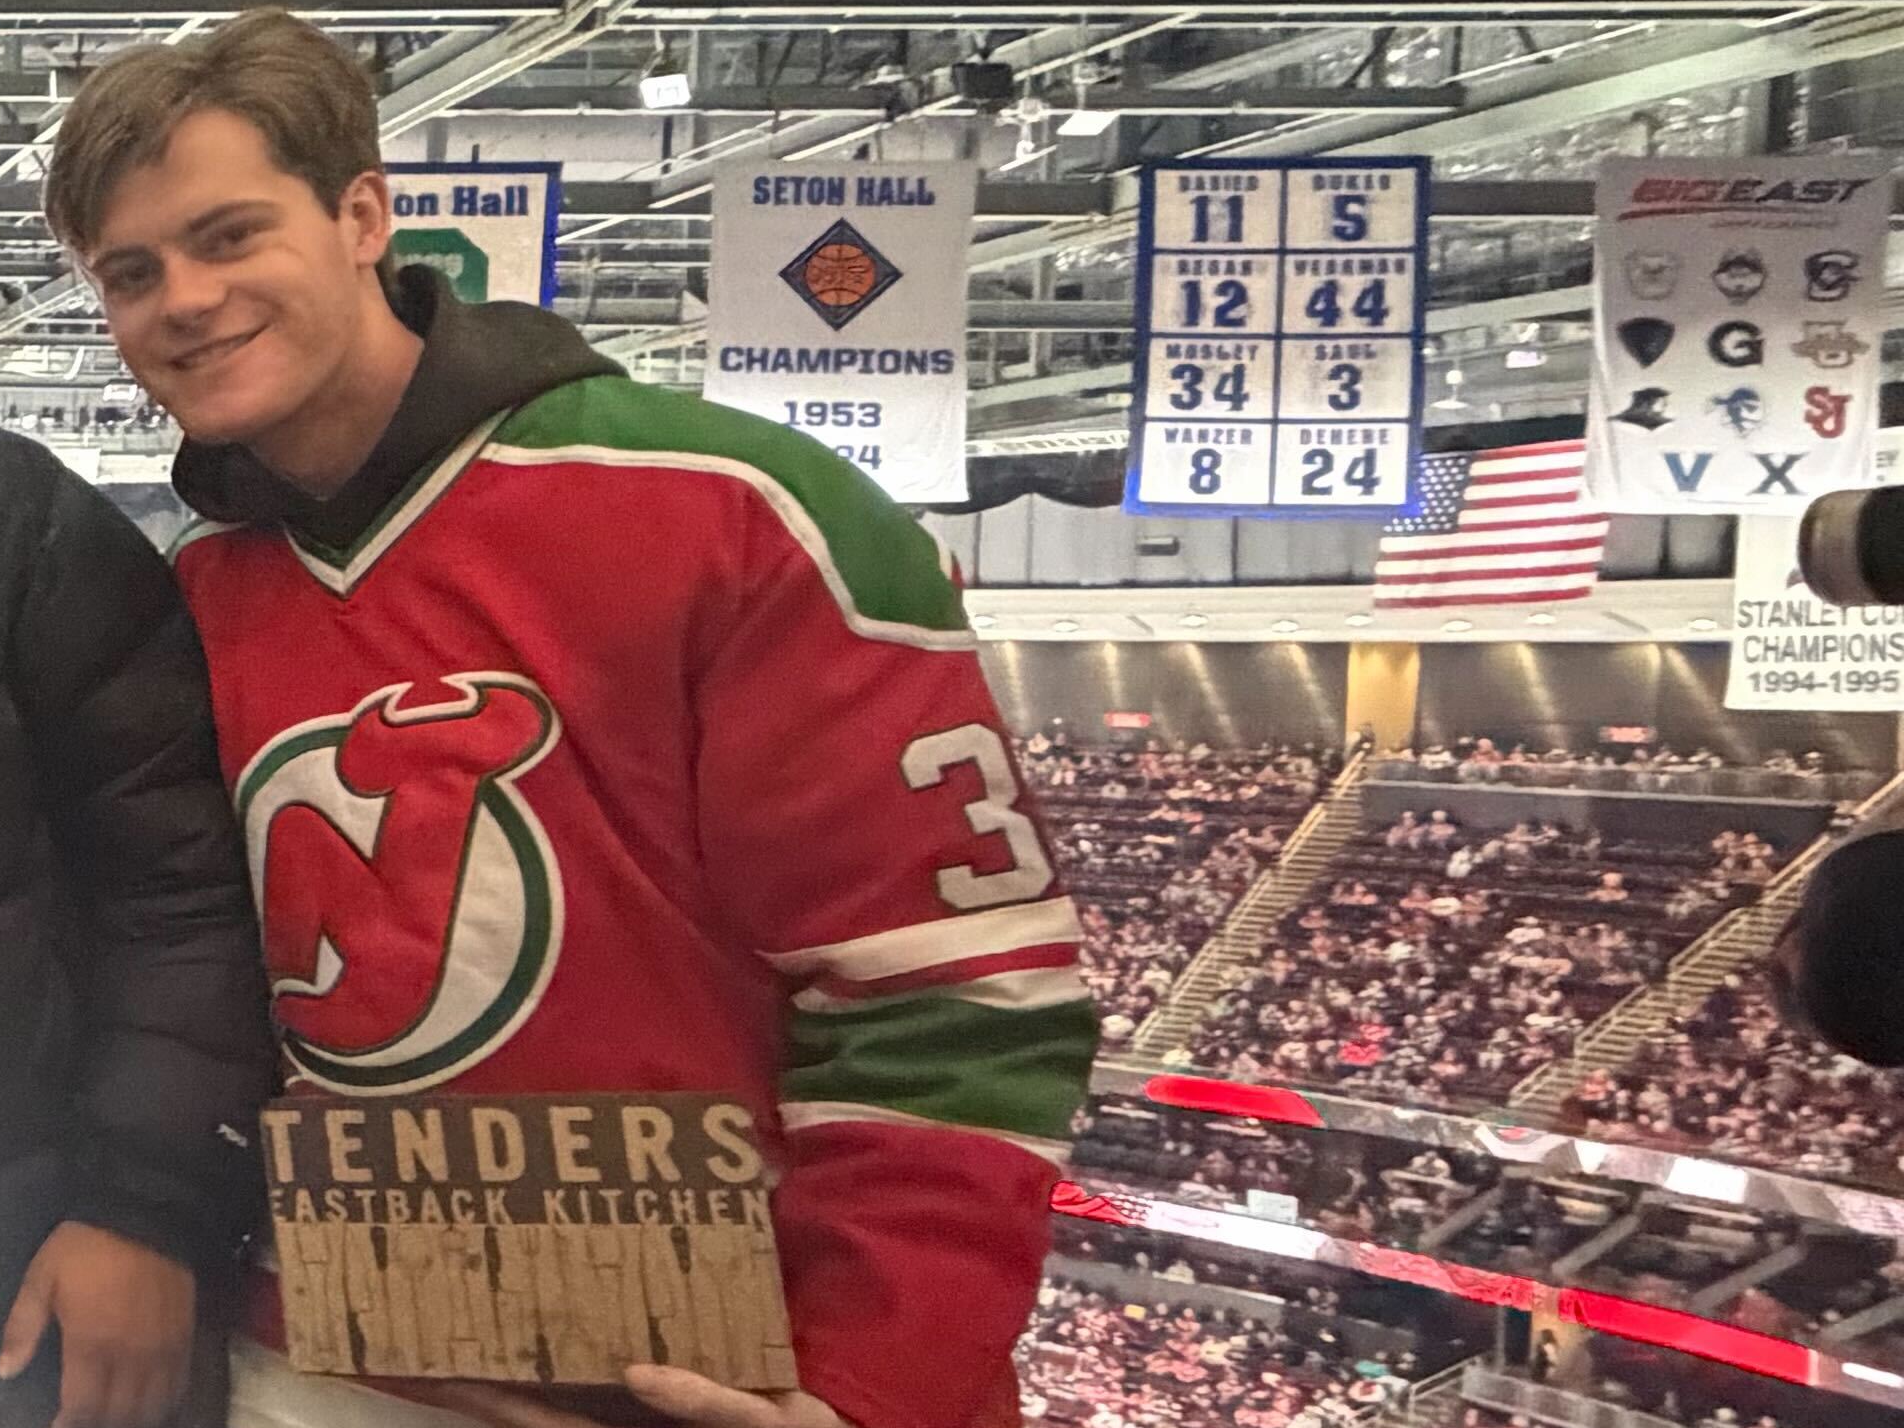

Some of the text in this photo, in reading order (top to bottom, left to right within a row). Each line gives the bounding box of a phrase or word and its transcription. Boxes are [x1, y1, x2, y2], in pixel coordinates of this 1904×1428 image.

[451, 184, 528, 216] Hall
[753, 176, 935, 206] SETON HALL
[1720, 178, 1882, 204] EAST
[1190, 194, 1368, 242] 11 5
[1180, 278, 1390, 327] 12 44
[719, 346, 954, 375] CHAMPIONS
[1169, 363, 1362, 411] 34 3
[784, 400, 882, 428] 1953
[1188, 448, 1382, 496] 8 24
[1664, 452, 1810, 495] V X
[1743, 632, 1904, 664] CHAMPIONS
[1748, 670, 1900, 694] 1994-1995
[261, 1103, 764, 1184] TENDERS
[543, 1186, 772, 1228] KITCHEN
